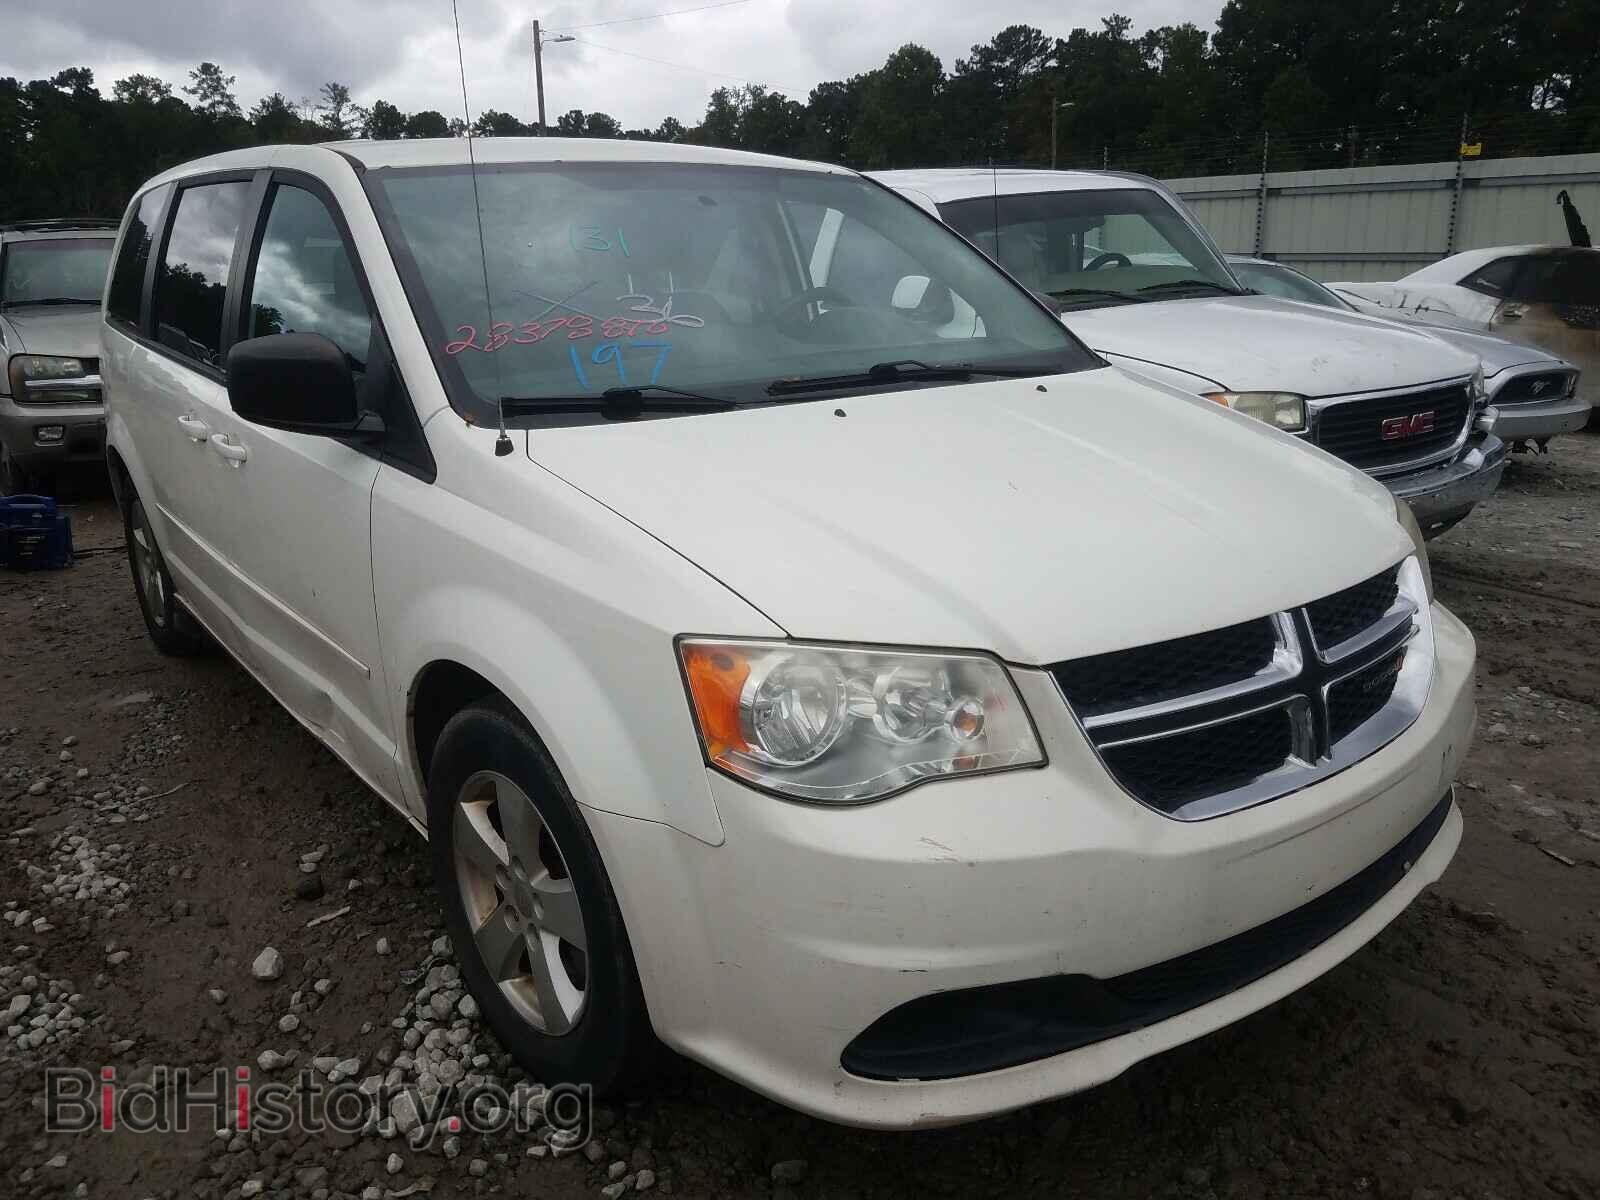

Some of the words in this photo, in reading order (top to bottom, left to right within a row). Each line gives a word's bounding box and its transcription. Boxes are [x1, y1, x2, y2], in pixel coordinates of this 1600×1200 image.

[568, 223, 630, 257] 131
[569, 341, 672, 390] 197
[1382, 411, 1435, 441] GMC
